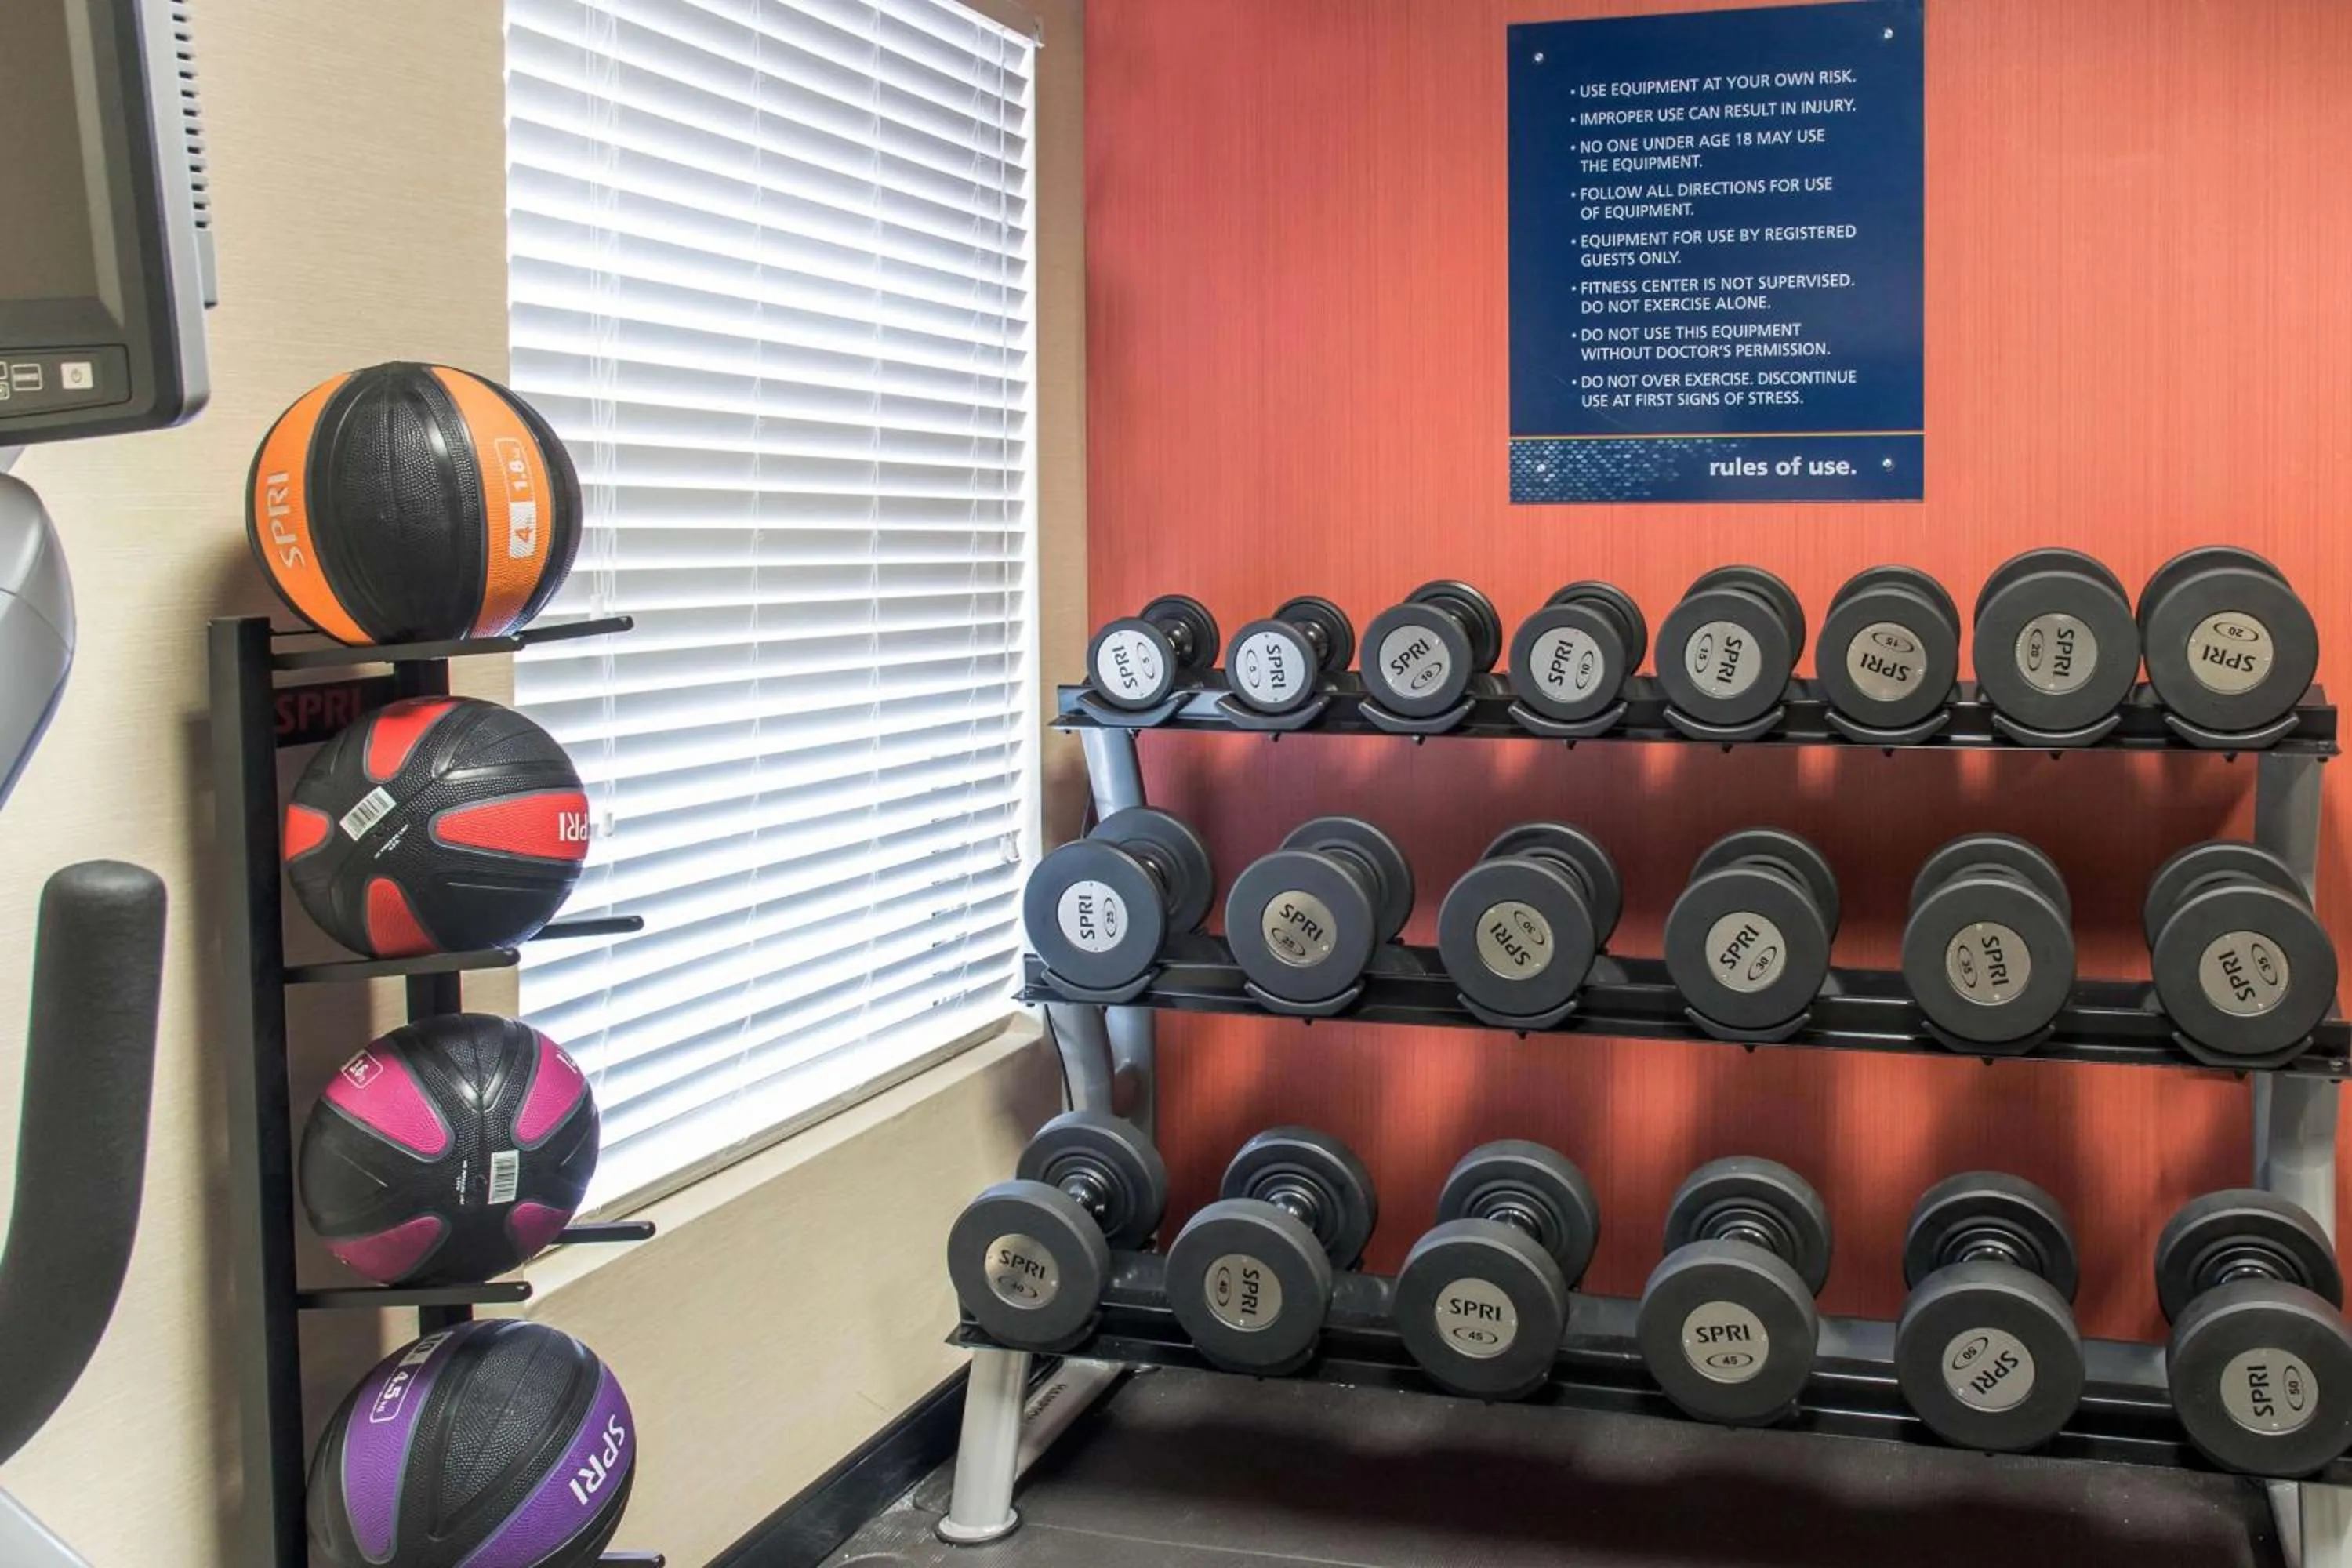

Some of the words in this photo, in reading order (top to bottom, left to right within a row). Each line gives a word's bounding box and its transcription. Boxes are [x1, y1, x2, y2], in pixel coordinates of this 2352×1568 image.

[1580, 84, 1606, 98] USE
[1611, 78, 1699, 96] EQUIPMENT
[1703, 77, 1722, 90] AT
[1726, 74, 1770, 89] YOUR
[1774, 71, 1815, 87] OWN
[1819, 69, 1857, 85] RISK.
[1580, 109, 1653, 125] IMPROPER
[1657, 107, 1685, 122] USE
[1688, 106, 1720, 120] CAN
[1724, 102, 1777, 118] RESULT
[1781, 101, 1796, 115] IN
[1801, 98, 1856, 114] INJURY.
[1580, 140, 1603, 154] NO
[1606, 138, 1638, 152] ONE
[1642, 136, 1694, 151] UNDER
[1699, 133, 1730, 147] AGE
[1737, 132, 1752, 146] 18
[1757, 130, 1793, 145] MAY
[1797, 128, 1825, 143] USE
[1580, 159, 1608, 172] THE
[1613, 154, 1703, 172] EQUIPMENT.
[1580, 185, 1642, 201] FOLLOW
[1646, 184, 1673, 198] ALL
[1677, 180, 1766, 197] DIRECTIONS
[1769, 178, 1800, 192] FOR
[1804, 176, 1832, 191] USE
[1580, 206, 1600, 220] OF
[1605, 202, 1694, 220] EQUIPMENT.
[1581, 231, 1669, 249] EQUIPMENT
[1673, 230, 1702, 244] FOR
[1707, 229, 1735, 243] USE
[1740, 228, 1760, 242] BY
[1765, 224, 1857, 241] REGISTERED
[1580, 252, 1635, 267] GUESTS
[1639, 250, 1681, 265] ONLY.
[1581, 280, 1638, 295] FITNESS
[1642, 278, 1699, 293] CENTER
[1704, 277, 1716, 291] IS
[1721, 276, 1754, 291] NOT
[1758, 273, 1855, 289] SUPERVISED.
[1581, 300, 1604, 314] DO
[1608, 299, 1640, 313] NOT
[1644, 297, 1711, 312] EXERCISE
[1715, 296, 1771, 310] ALONE.
[1581, 328, 1604, 342] DO
[1608, 327, 1639, 341] NOT
[1644, 326, 1671, 340] USE
[1675, 325, 1708, 339] THIS
[1711, 322, 1802, 339] EQUIPMENT
[1581, 346, 1652, 361] WITHOUT
[1656, 344, 1732, 359] DOCTOR'S
[1735, 342, 1831, 358] PERMISSION.
[1581, 376, 1604, 388] DO
[1607, 374, 1639, 388] NOT
[1641, 373, 1681, 387] OVER
[1685, 372, 1754, 387] EXERCISE.
[1758, 369, 1857, 385] DISCONTINUE
[1581, 394, 1608, 408] USE
[1613, 394, 1632, 407] AT
[1635, 393, 1674, 407] FIRST
[1677, 392, 1720, 406] SIGNS
[1724, 391, 1744, 405] OF
[1748, 390, 1803, 405] STRESS.
[1709, 456, 1769, 477] rules
[1775, 456, 1802, 476] of
[1809, 460, 1857, 476] use.
[267, 471, 305, 570] SPRI
[515, 526, 532, 543] 4
[1886, 637, 1899, 647] 15
[2228, 626, 2244, 637] 20
[1391, 638, 1430, 675] SPRI
[1698, 646, 1708, 660] 15
[1717, 636, 1742, 684] SPRI
[2031, 644, 2039, 659] 20
[2053, 627, 2074, 677] SPRI
[2202, 644, 2256, 672] SPRI
[1112, 646, 1138, 689] SPRI
[1267, 644, 1286, 688] SPRI
[1548, 640, 1573, 686] SPRI
[1581, 661, 1591, 677] 10
[1860, 653, 1911, 681] SPRI
[1421, 670, 1433, 681] 10
[274, 691, 361, 734] SPRI
[559, 812, 587, 841] PRI
[1079, 895, 1095, 939] SPRI
[1107, 911, 1115, 924] 25
[1280, 904, 1323, 942] SPRI
[1523, 920, 1536, 934] 30
[1282, 936, 1294, 947] 25
[1490, 922, 1530, 965] SPRI
[1720, 924, 1759, 970] SPRI
[1756, 956, 1769, 970] 30
[1961, 960, 1973, 974] 35
[1982, 936, 2009, 986] SPRI
[2258, 956, 2271, 971] 35
[2219, 951, 2256, 1001] SPRI
[1000, 1250, 1045, 1279] SPRI
[1011, 1283, 1024, 1293] 40
[1220, 1279, 1228, 1294] 40
[1242, 1268, 1259, 1315] SPRI
[1450, 1298, 1501, 1321] SPRI
[1468, 1332, 1483, 1341] 45
[1696, 1325, 1750, 1343] SPRI
[1722, 1356, 1738, 1365] 45
[1962, 1346, 1977, 1360] 50
[1970, 1351, 2019, 1394] SPRI
[2247, 1365, 2274, 1417] SPRI
[2288, 1381, 2300, 1396] 50
[568, 1414, 626, 1506] SPRI
